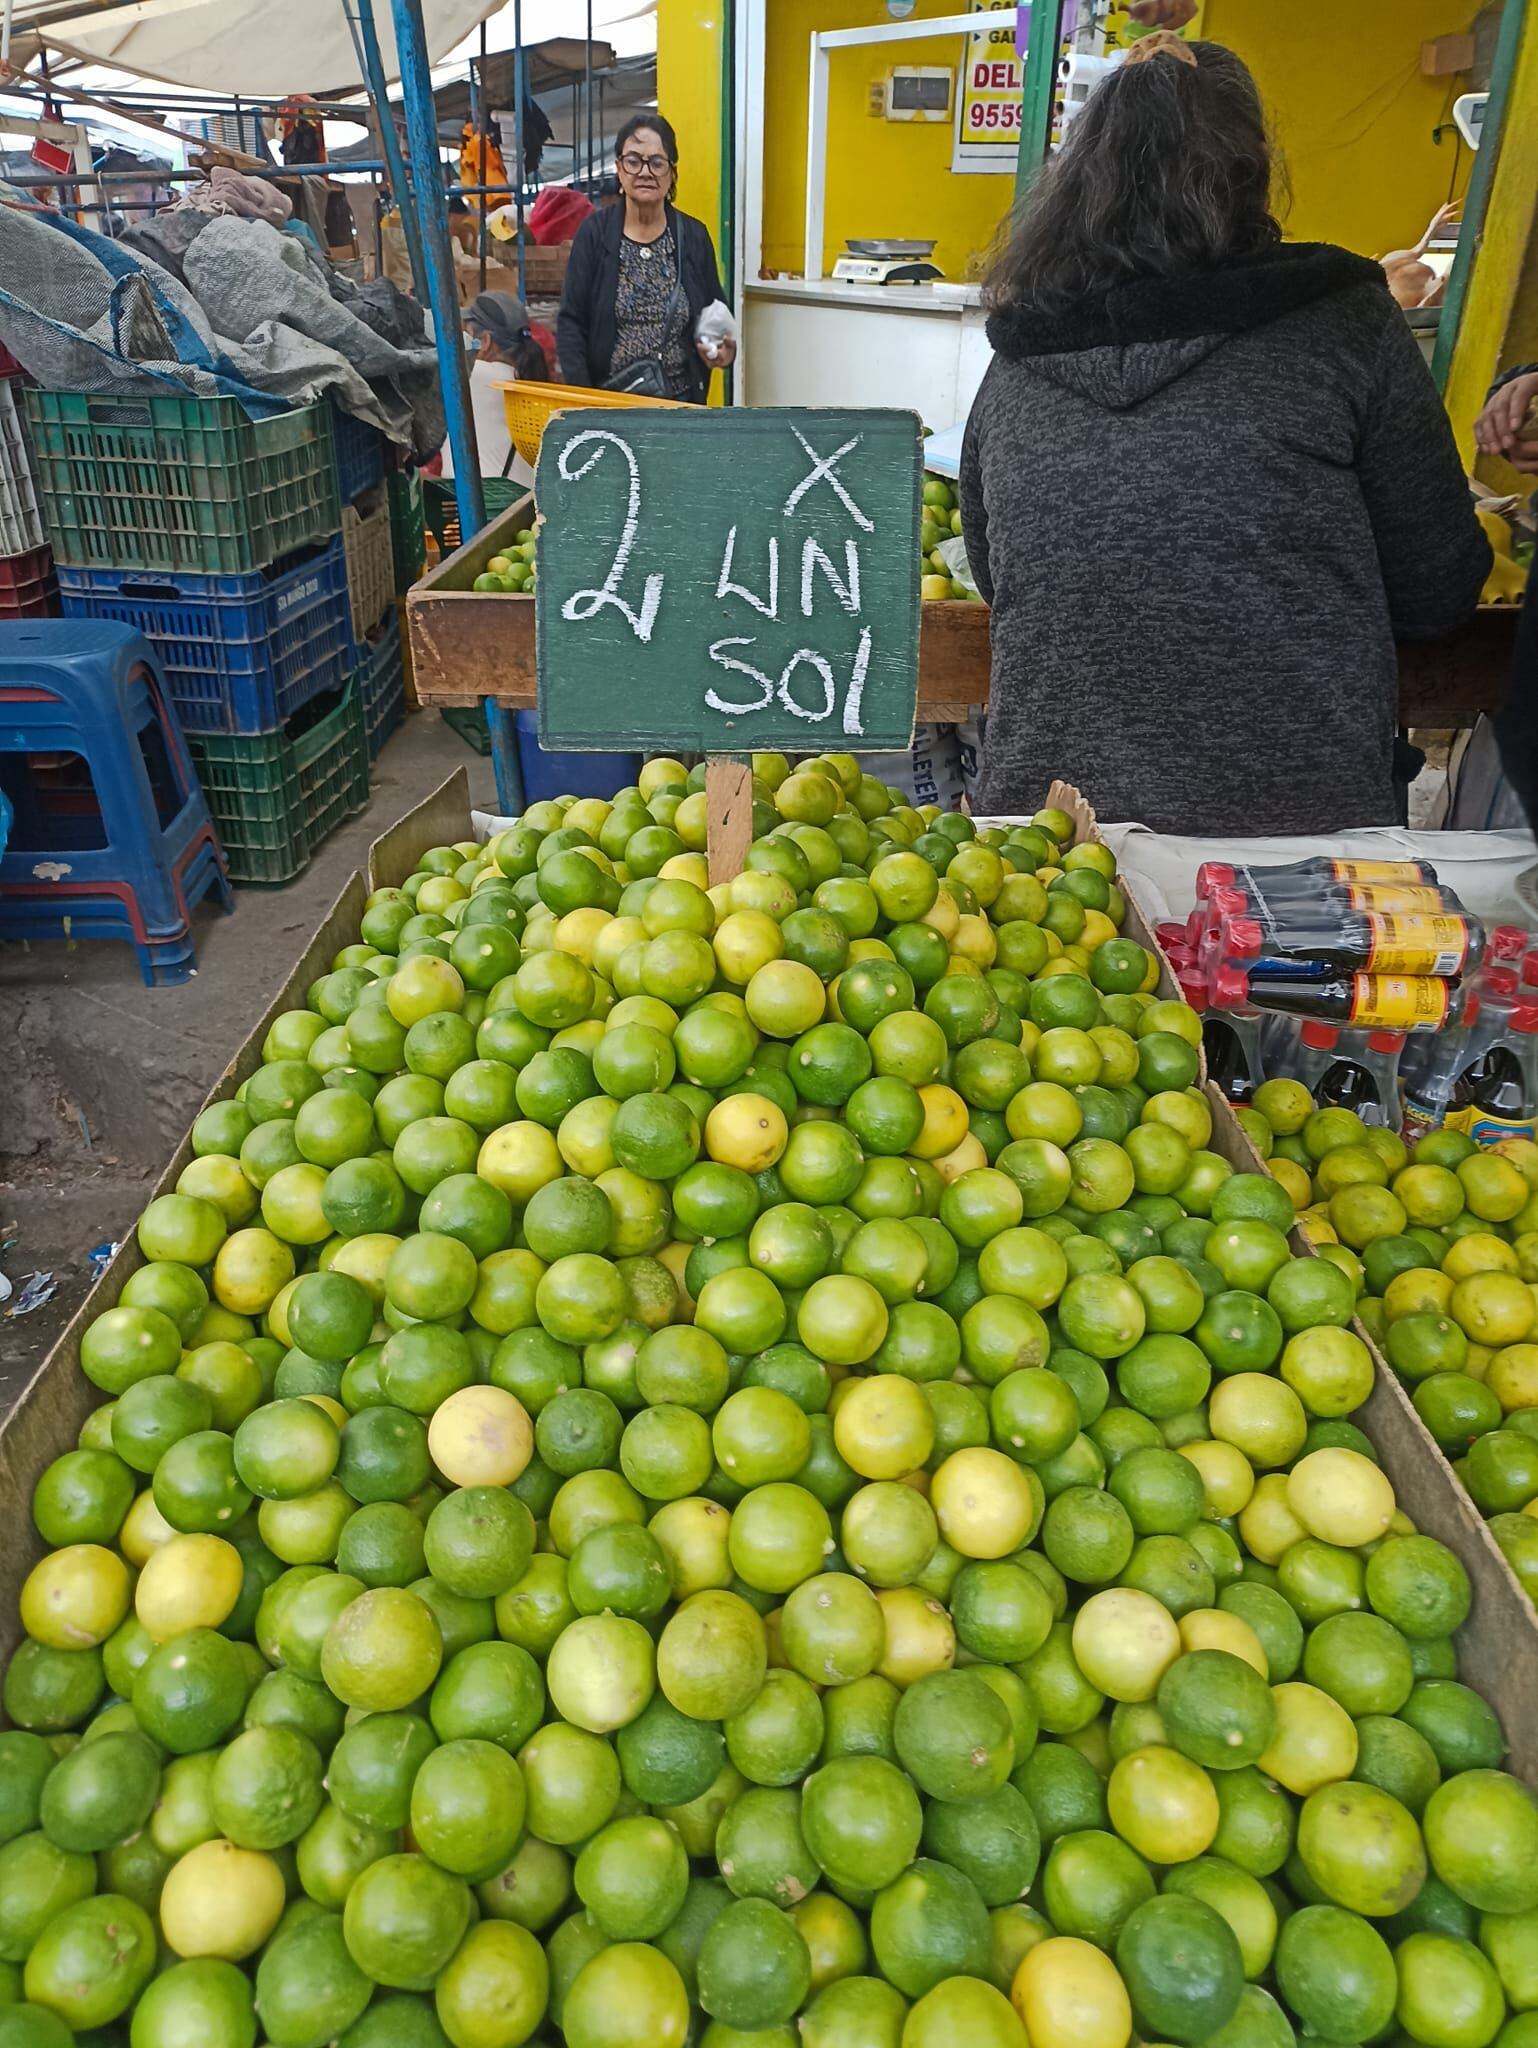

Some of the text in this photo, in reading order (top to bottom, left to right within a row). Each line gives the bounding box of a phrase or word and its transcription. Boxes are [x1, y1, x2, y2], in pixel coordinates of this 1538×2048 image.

[973, 63, 1025, 88] DEL
[557, 430, 664, 642] 2
[715, 524, 861, 622] UN
